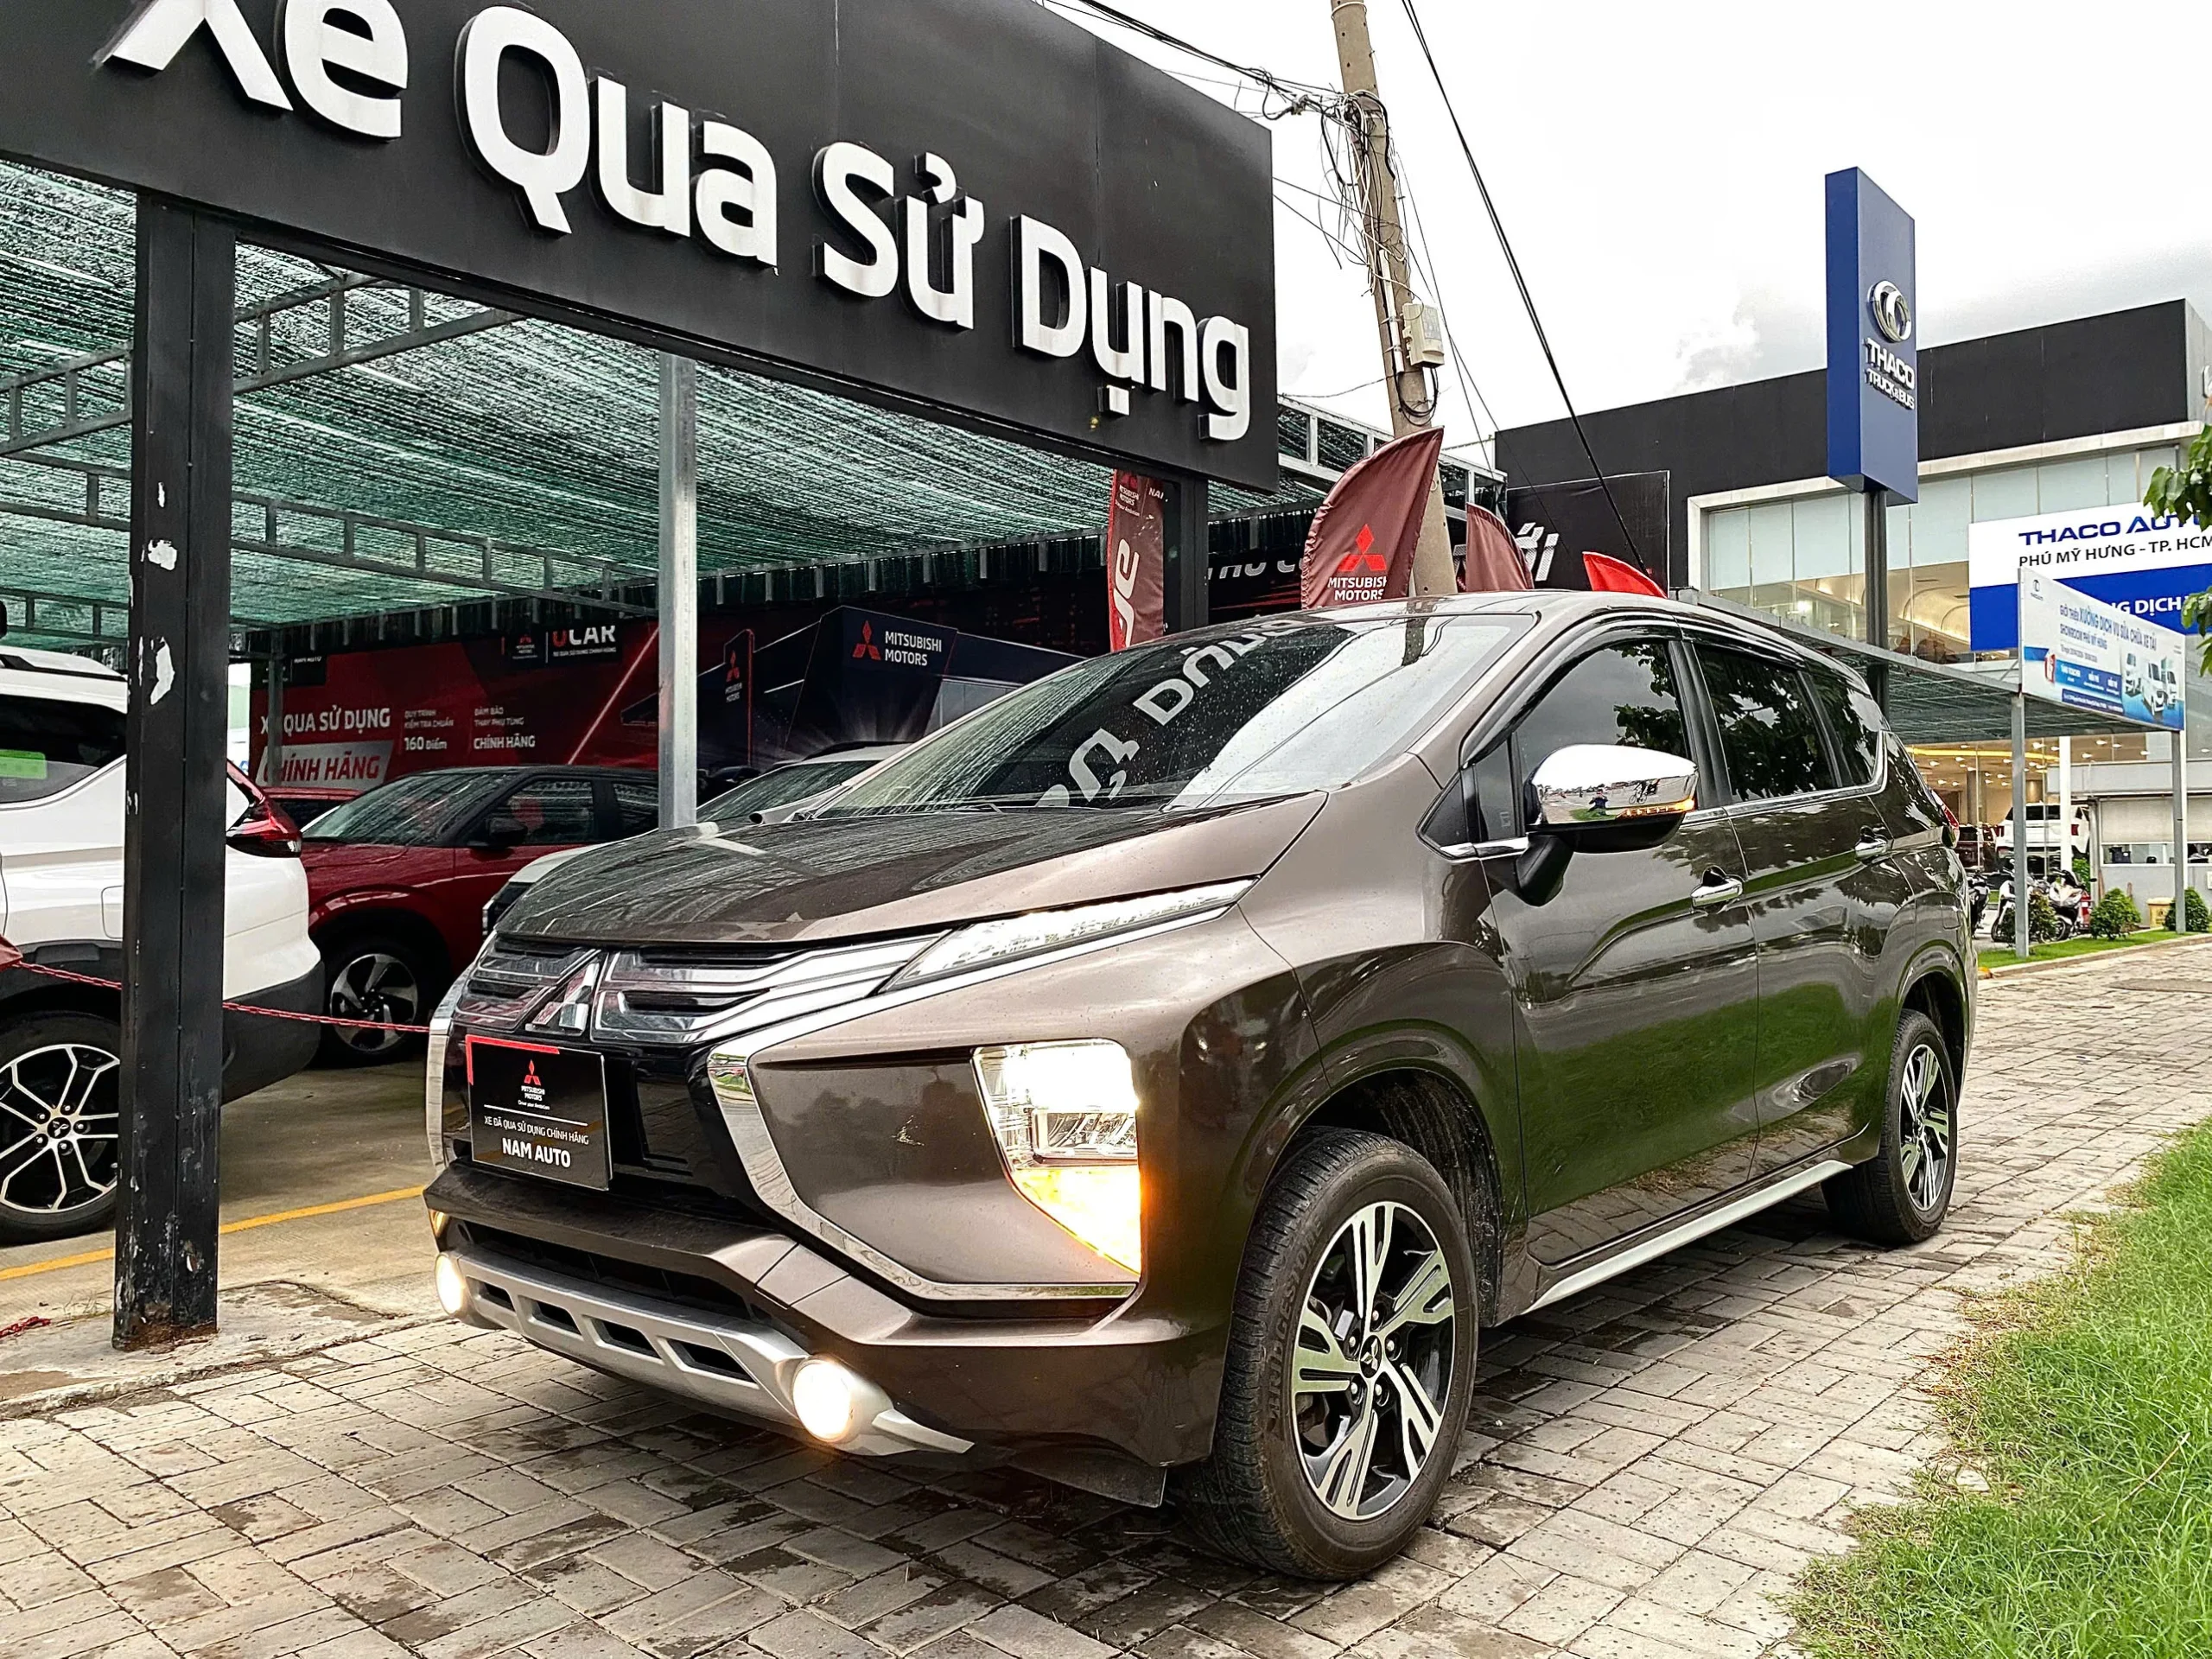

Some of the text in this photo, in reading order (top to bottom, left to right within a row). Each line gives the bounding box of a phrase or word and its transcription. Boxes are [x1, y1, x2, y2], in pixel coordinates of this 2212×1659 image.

[462, 5, 778, 268] Qua
[817, 142, 985, 330] Sử
[1016, 213, 1250, 442] Dụng
[1866, 337, 1915, 391] THACO
[2018, 521, 2122, 546] THACO
[2018, 550, 2052, 567] PHÚ
[2085, 544, 2136, 561] HƯNG
[2148, 540, 2172, 554] TP.
[1326, 575, 1388, 588] MITSUBIS
[2134, 596, 2182, 617] DỊCH
[885, 631, 943, 652] MITSUBISHI
[885, 648, 929, 667] MOTORS
[283, 713, 316, 736] QUA
[319, 704, 342, 731] SỬ
[345, 708, 391, 734] DỤNG
[404, 736, 424, 750] 160
[474, 733, 536, 749] CHÍNH HÃNG
[324, 750, 381, 781] HÃNG
[484, 1116, 589, 1146] XE ĐÃ QUA SỬ DỤNG CHÍNH HÃNG
[502, 1137, 571, 1168] NAM AUTO
